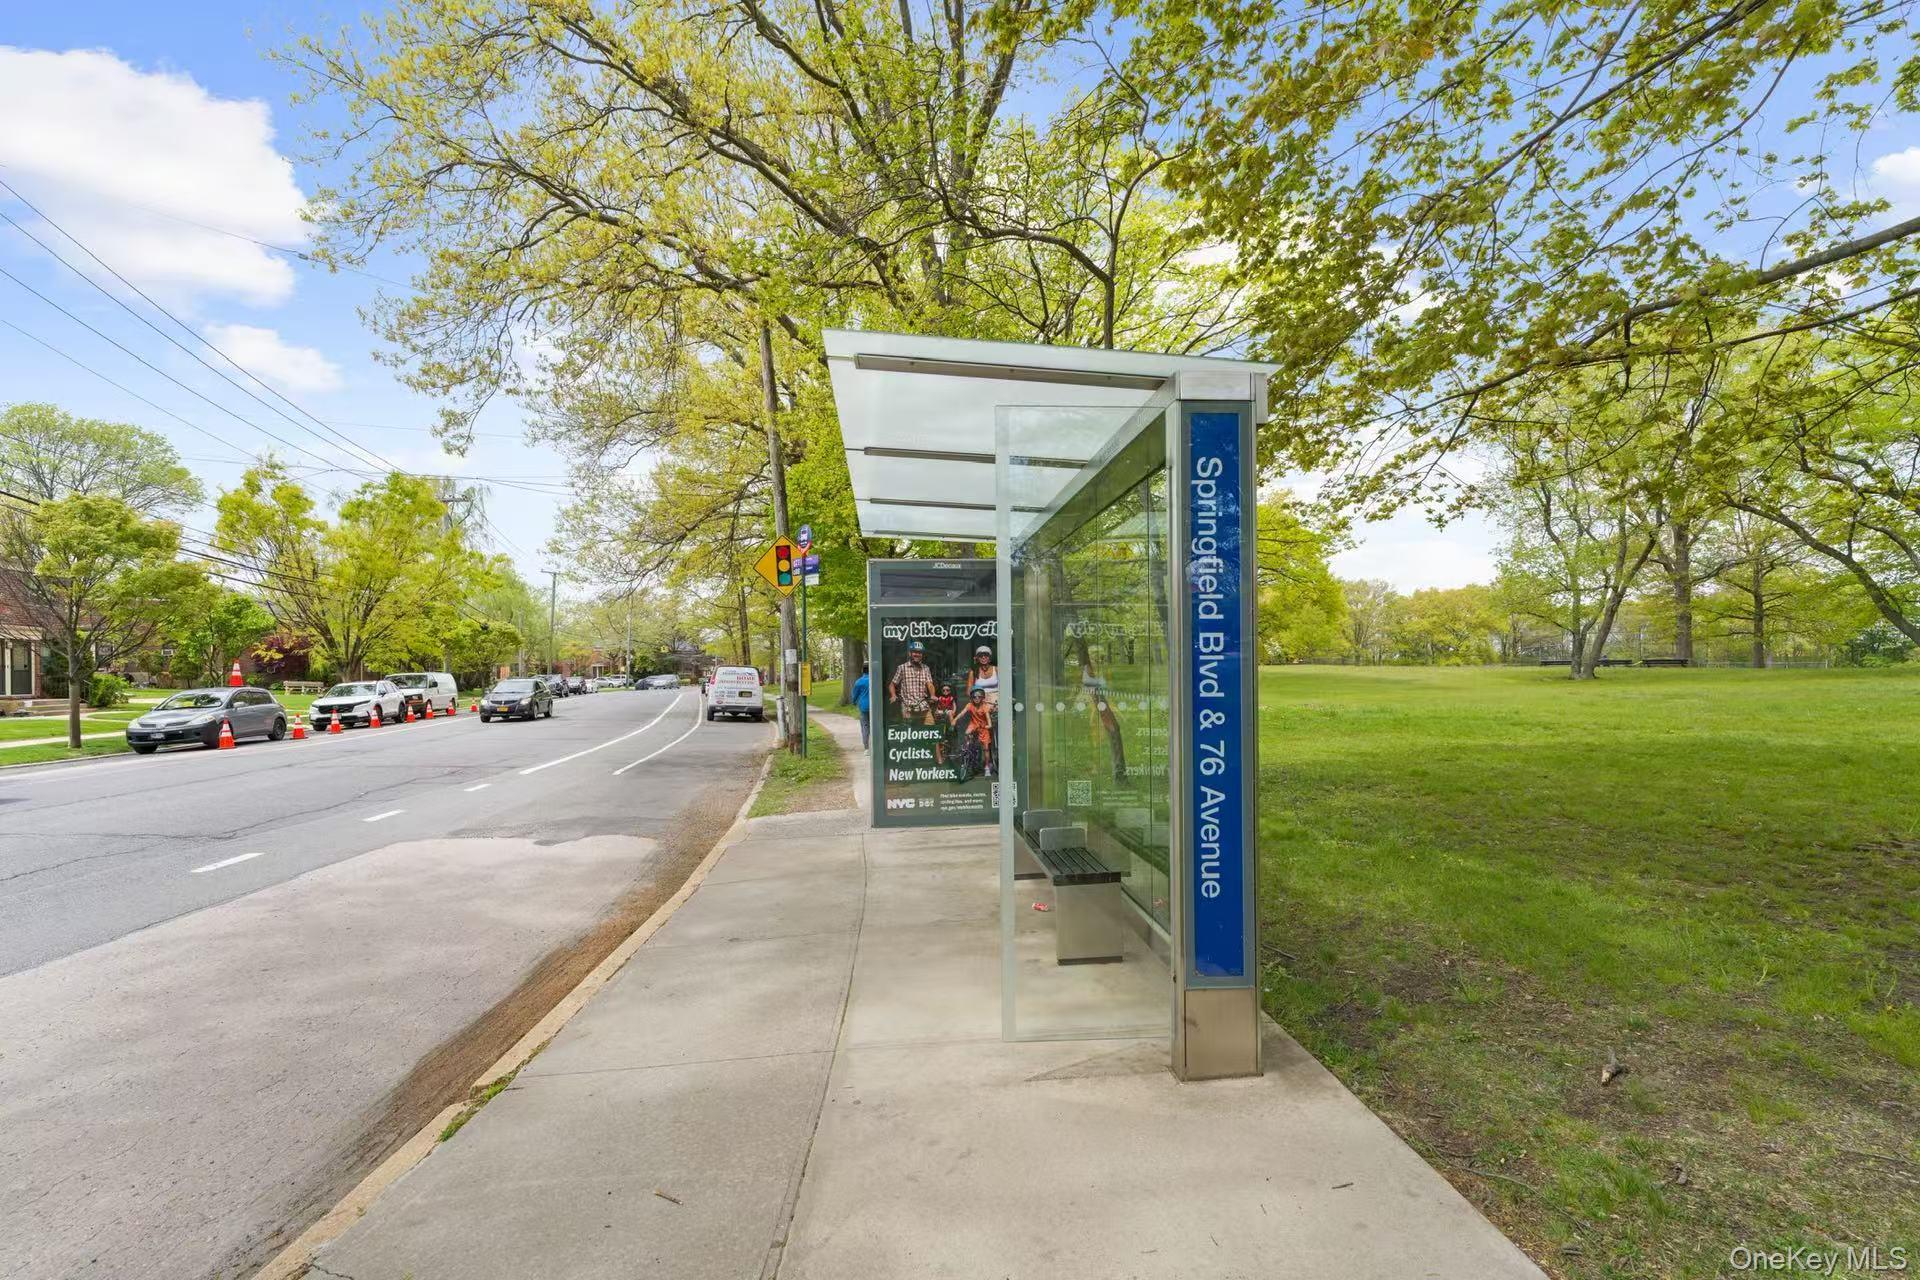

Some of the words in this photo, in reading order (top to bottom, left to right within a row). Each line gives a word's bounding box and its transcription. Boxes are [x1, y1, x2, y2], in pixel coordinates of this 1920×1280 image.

[1191, 456, 1224, 620] Springfield
[883, 625, 909, 641] my
[910, 621, 948, 639] bike,
[949, 623, 977, 640] my
[1199, 632, 1225, 698] Blvd
[1199, 708, 1226, 731] &
[887, 727, 942, 743] Explorers.
[888, 747, 933, 762] Cyclists.
[1199, 740, 1225, 776] 76
[889, 768, 913, 782] New
[915, 766, 958, 781] Yorkers.
[886, 798, 916, 810] NYC
[1200, 785, 1226, 899] Avenue
